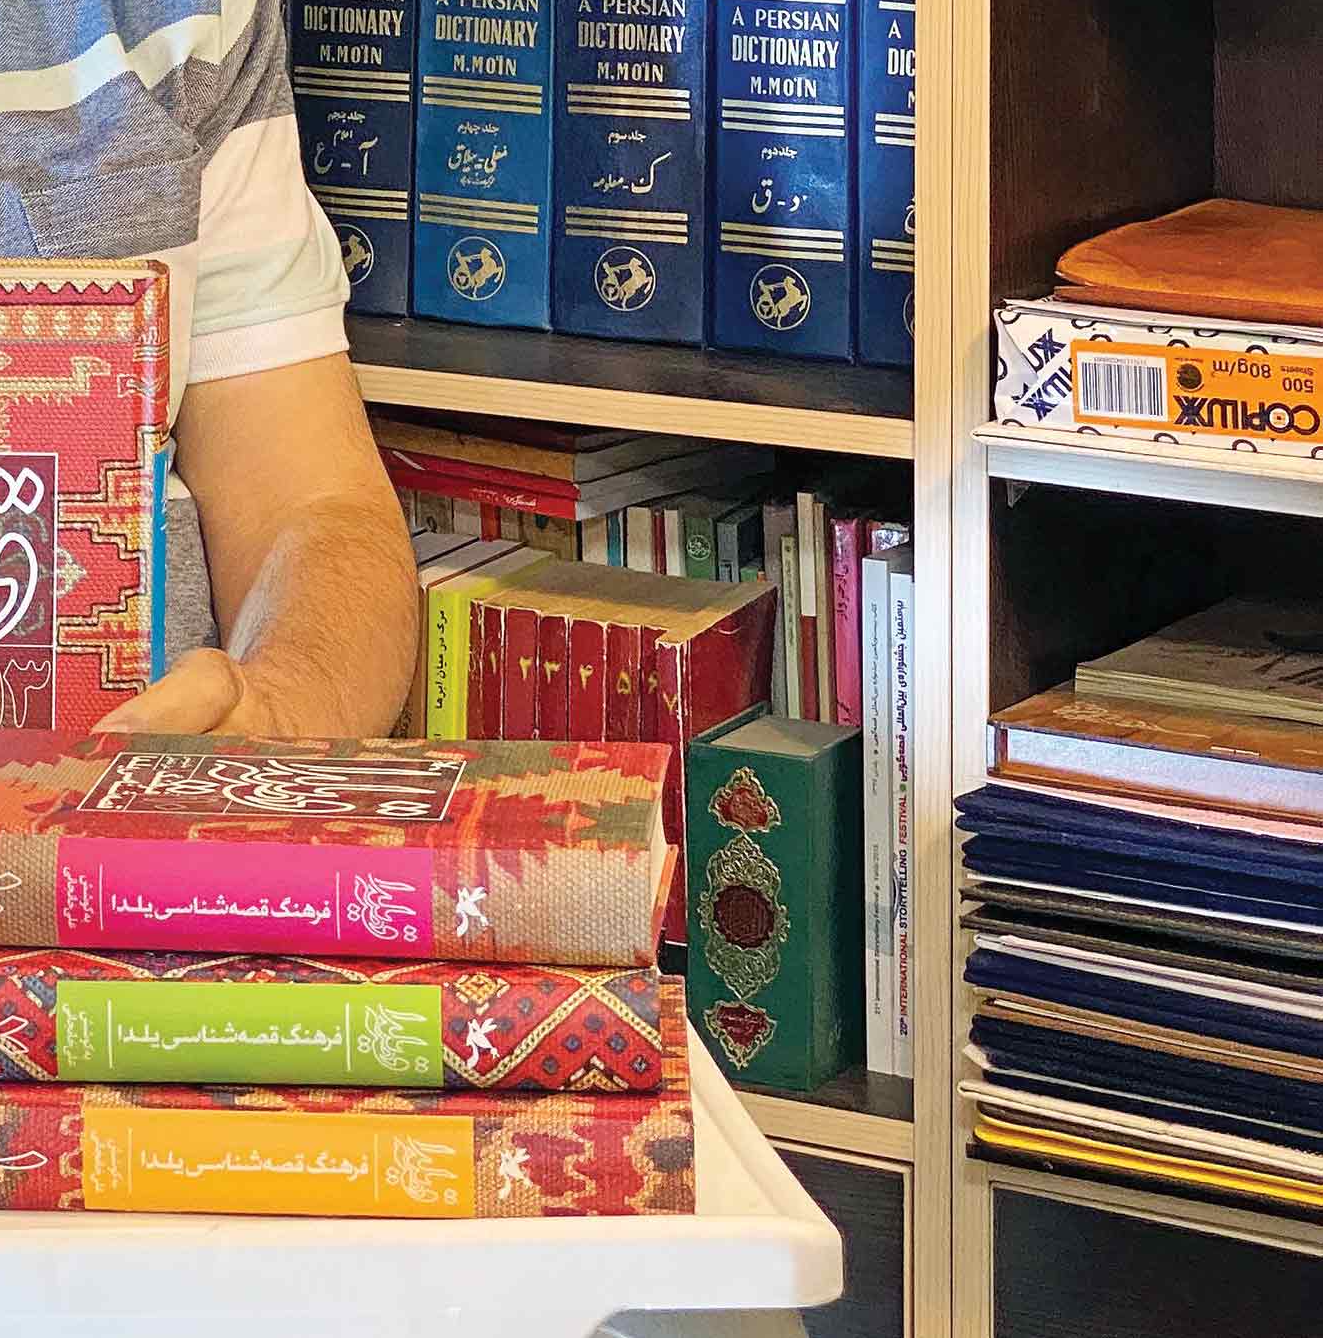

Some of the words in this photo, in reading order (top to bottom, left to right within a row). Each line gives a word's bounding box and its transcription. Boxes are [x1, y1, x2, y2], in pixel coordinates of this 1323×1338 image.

[303, 5, 405, 38] DICTIONARY
[435, 13, 539, 49] DICTIONARY
[732, 6, 745, 27] A
[755, 7, 840, 32] PERSIAN
[888, 19, 901, 39] A
[578, 20, 686, 55] DICTIONARY
[731, 34, 840, 70] DICTIONARY
[457, 121, 481, 135] چهارم
[482, 124, 500, 136] جلد
[607, 129, 628, 145] سوم
[627, 131, 647, 143] جلد
[314, 142, 333, 175] ع
[358, 136, 378, 176] آ
[760, 147, 780, 160] دوم
[779, 147, 798, 159] جلد
[751, 178, 773, 213] ق
[1282, 377, 1315, 395] 500
[1173, 394, 1321, 436] COPILUX
[436, 610, 449, 633] مرگ
[437, 636, 449, 651] در
[436, 654, 447, 679] میان
[489, 651, 497, 675] ۱
[518, 656, 533, 682] ۲
[543, 660, 562, 685] ۳
[579, 663, 594, 690] ۴
[616, 670, 631, 695] ۵
[436, 678, 449, 710] ابرها
[898, 794, 909, 845] FESTIVAL
[898, 849, 909, 929] STORYTELLING
[111, 893, 156, 918] یلدا
[270, 897, 332, 925] فرهنگ
[898, 931, 909, 1016] INTERNATIONAL
[117, 1023, 162, 1049] یلدا
[279, 1024, 343, 1051] فرهنگ
[140, 1149, 187, 1177] یلدا
[307, 1153, 370, 1182] فرهنگ
